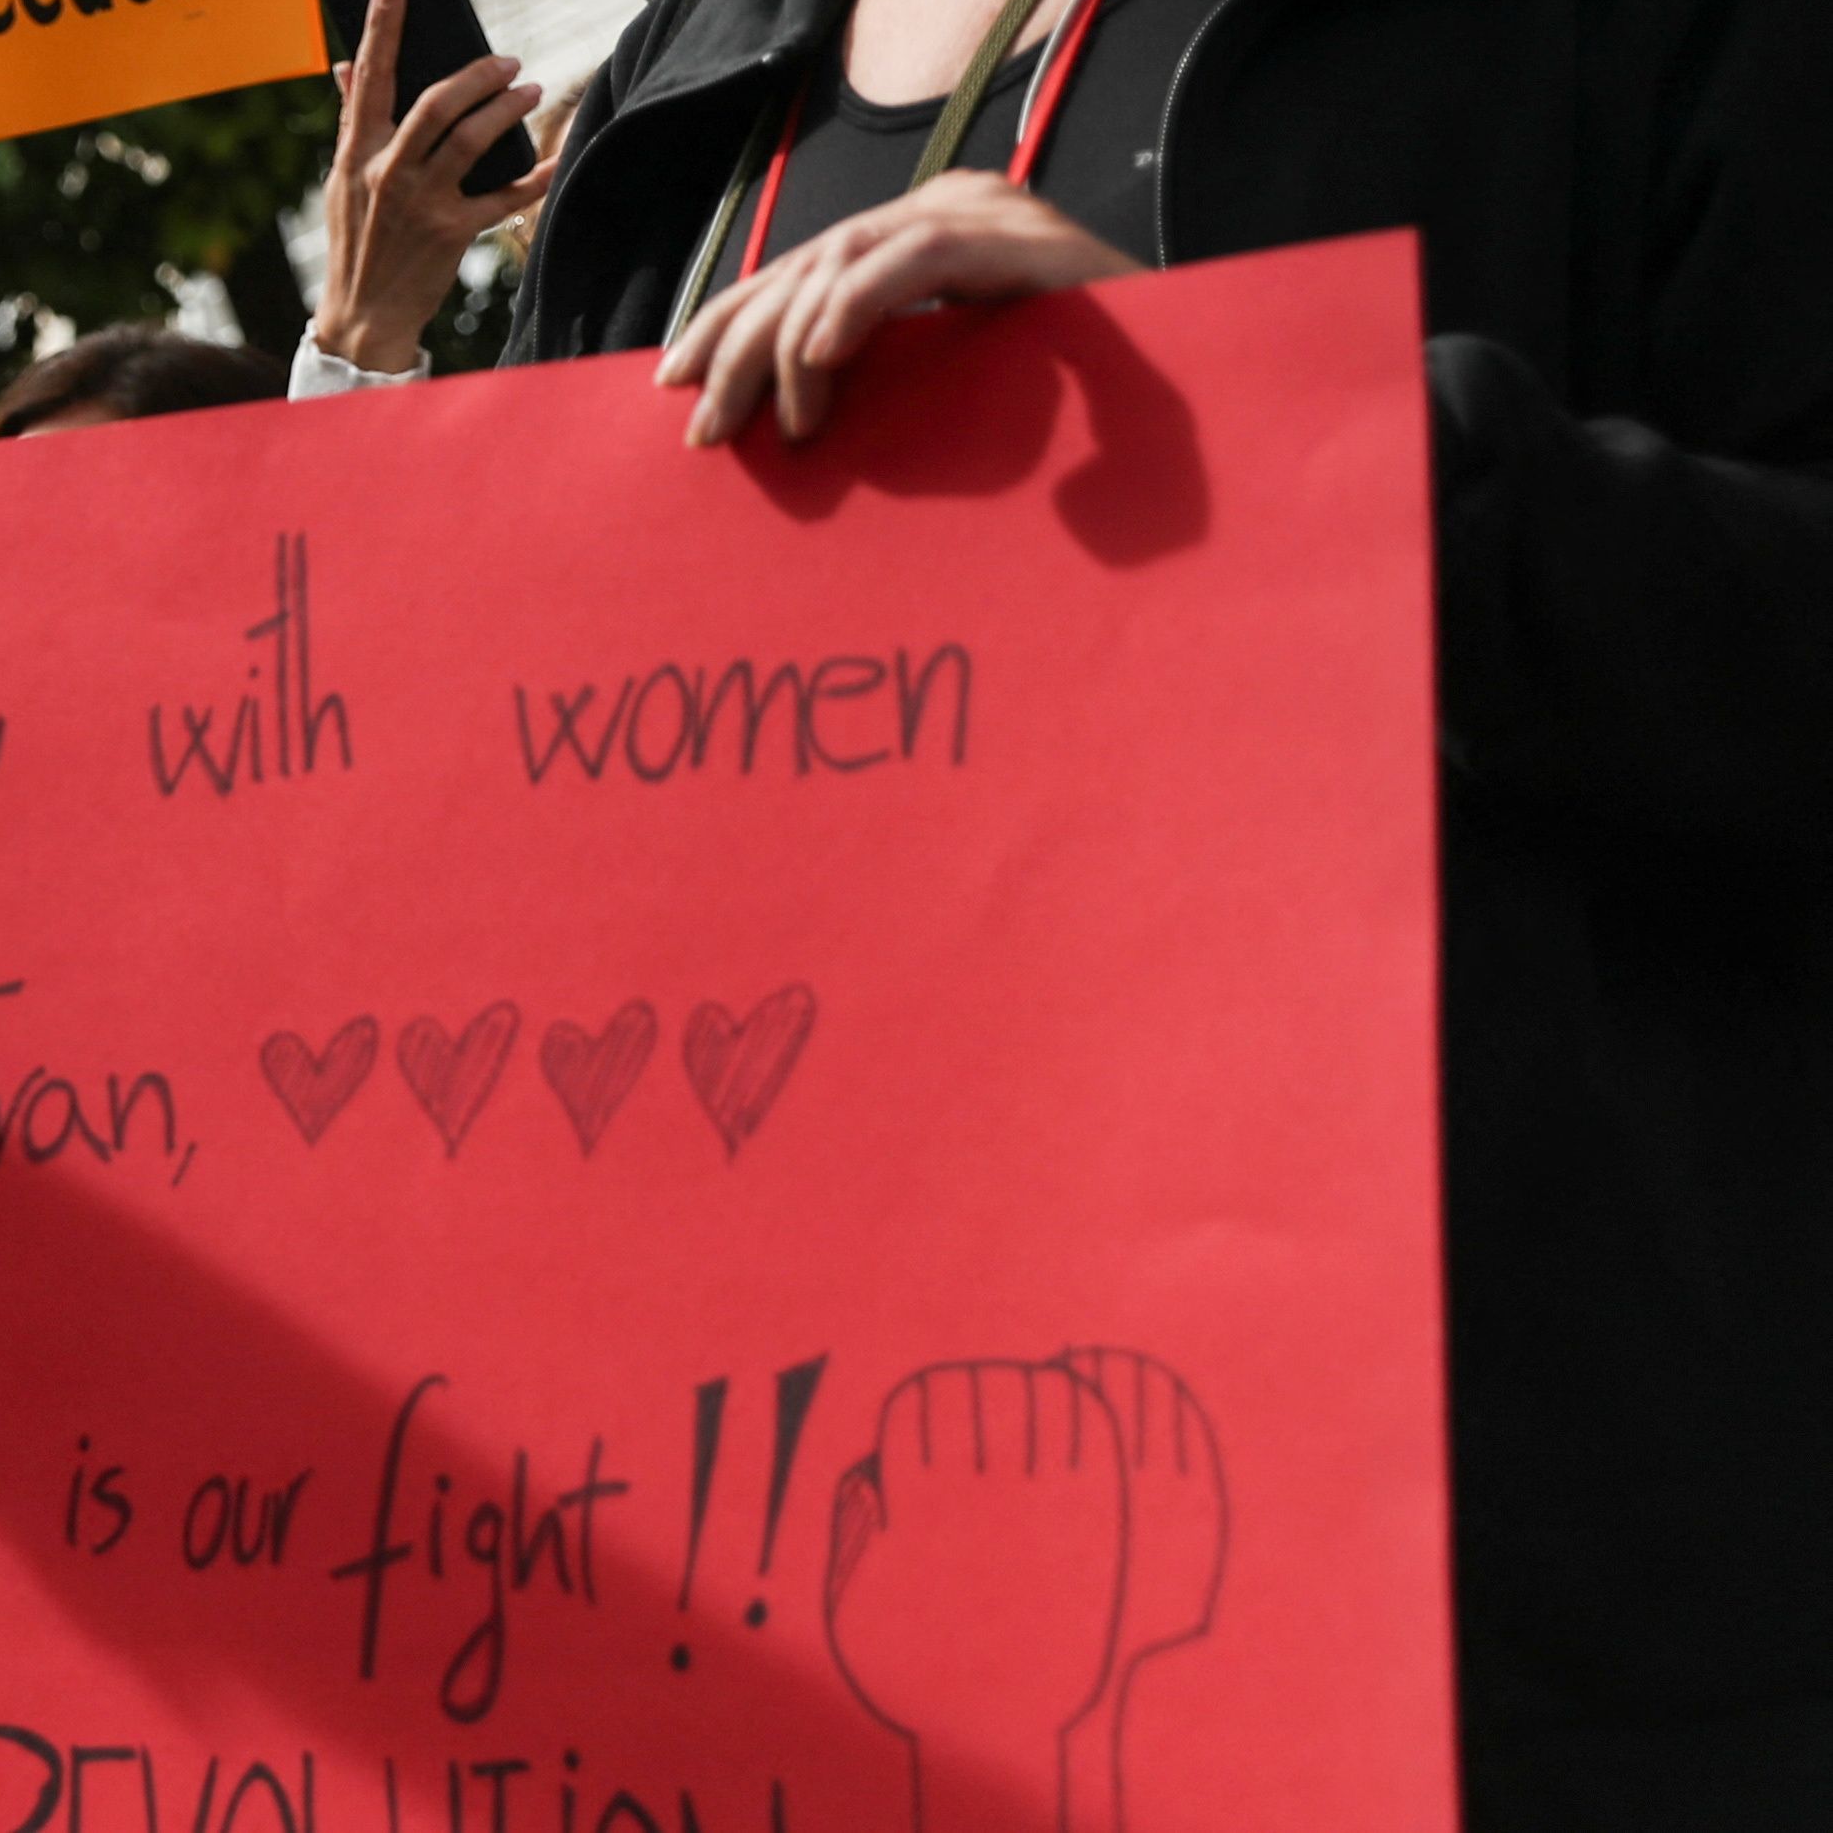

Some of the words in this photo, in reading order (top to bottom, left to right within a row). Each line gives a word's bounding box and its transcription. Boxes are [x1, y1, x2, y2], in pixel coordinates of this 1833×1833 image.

[148, 532, 354, 796] with
[513, 641, 973, 786] women
[65, 1435, 132, 1555] is
[183, 1467, 312, 1570] our
